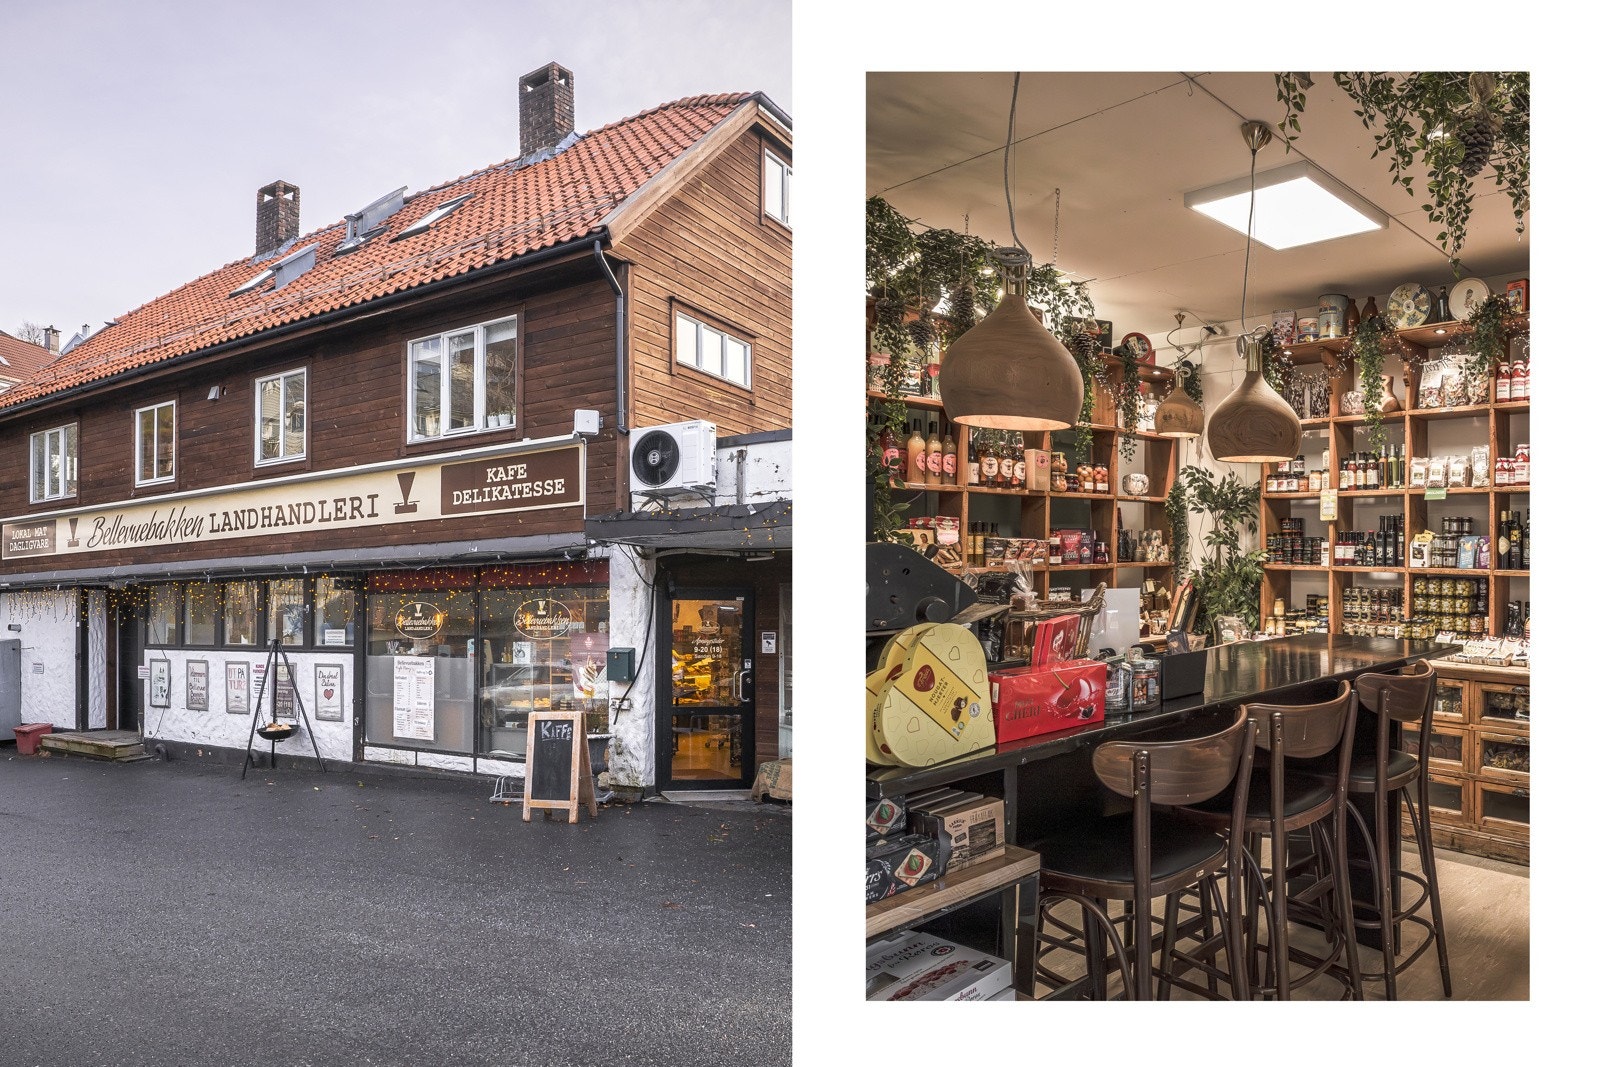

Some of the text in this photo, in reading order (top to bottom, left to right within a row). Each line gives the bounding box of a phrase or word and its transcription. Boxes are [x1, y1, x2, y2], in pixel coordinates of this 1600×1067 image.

[486, 463, 527, 483] KAFE
[452, 478, 566, 506] DELIKATESSE
[87, 493, 380, 548] Bellevuebakken LANDHANDLERI
[11, 526, 48, 540] LOKAL MAT
[9, 538, 50, 552] DAGLIGVARE
[693, 645, 723, 654] 9-20 (18)
[228, 667, 237, 679] UT
[1005, 705, 1041, 721] CHERI
